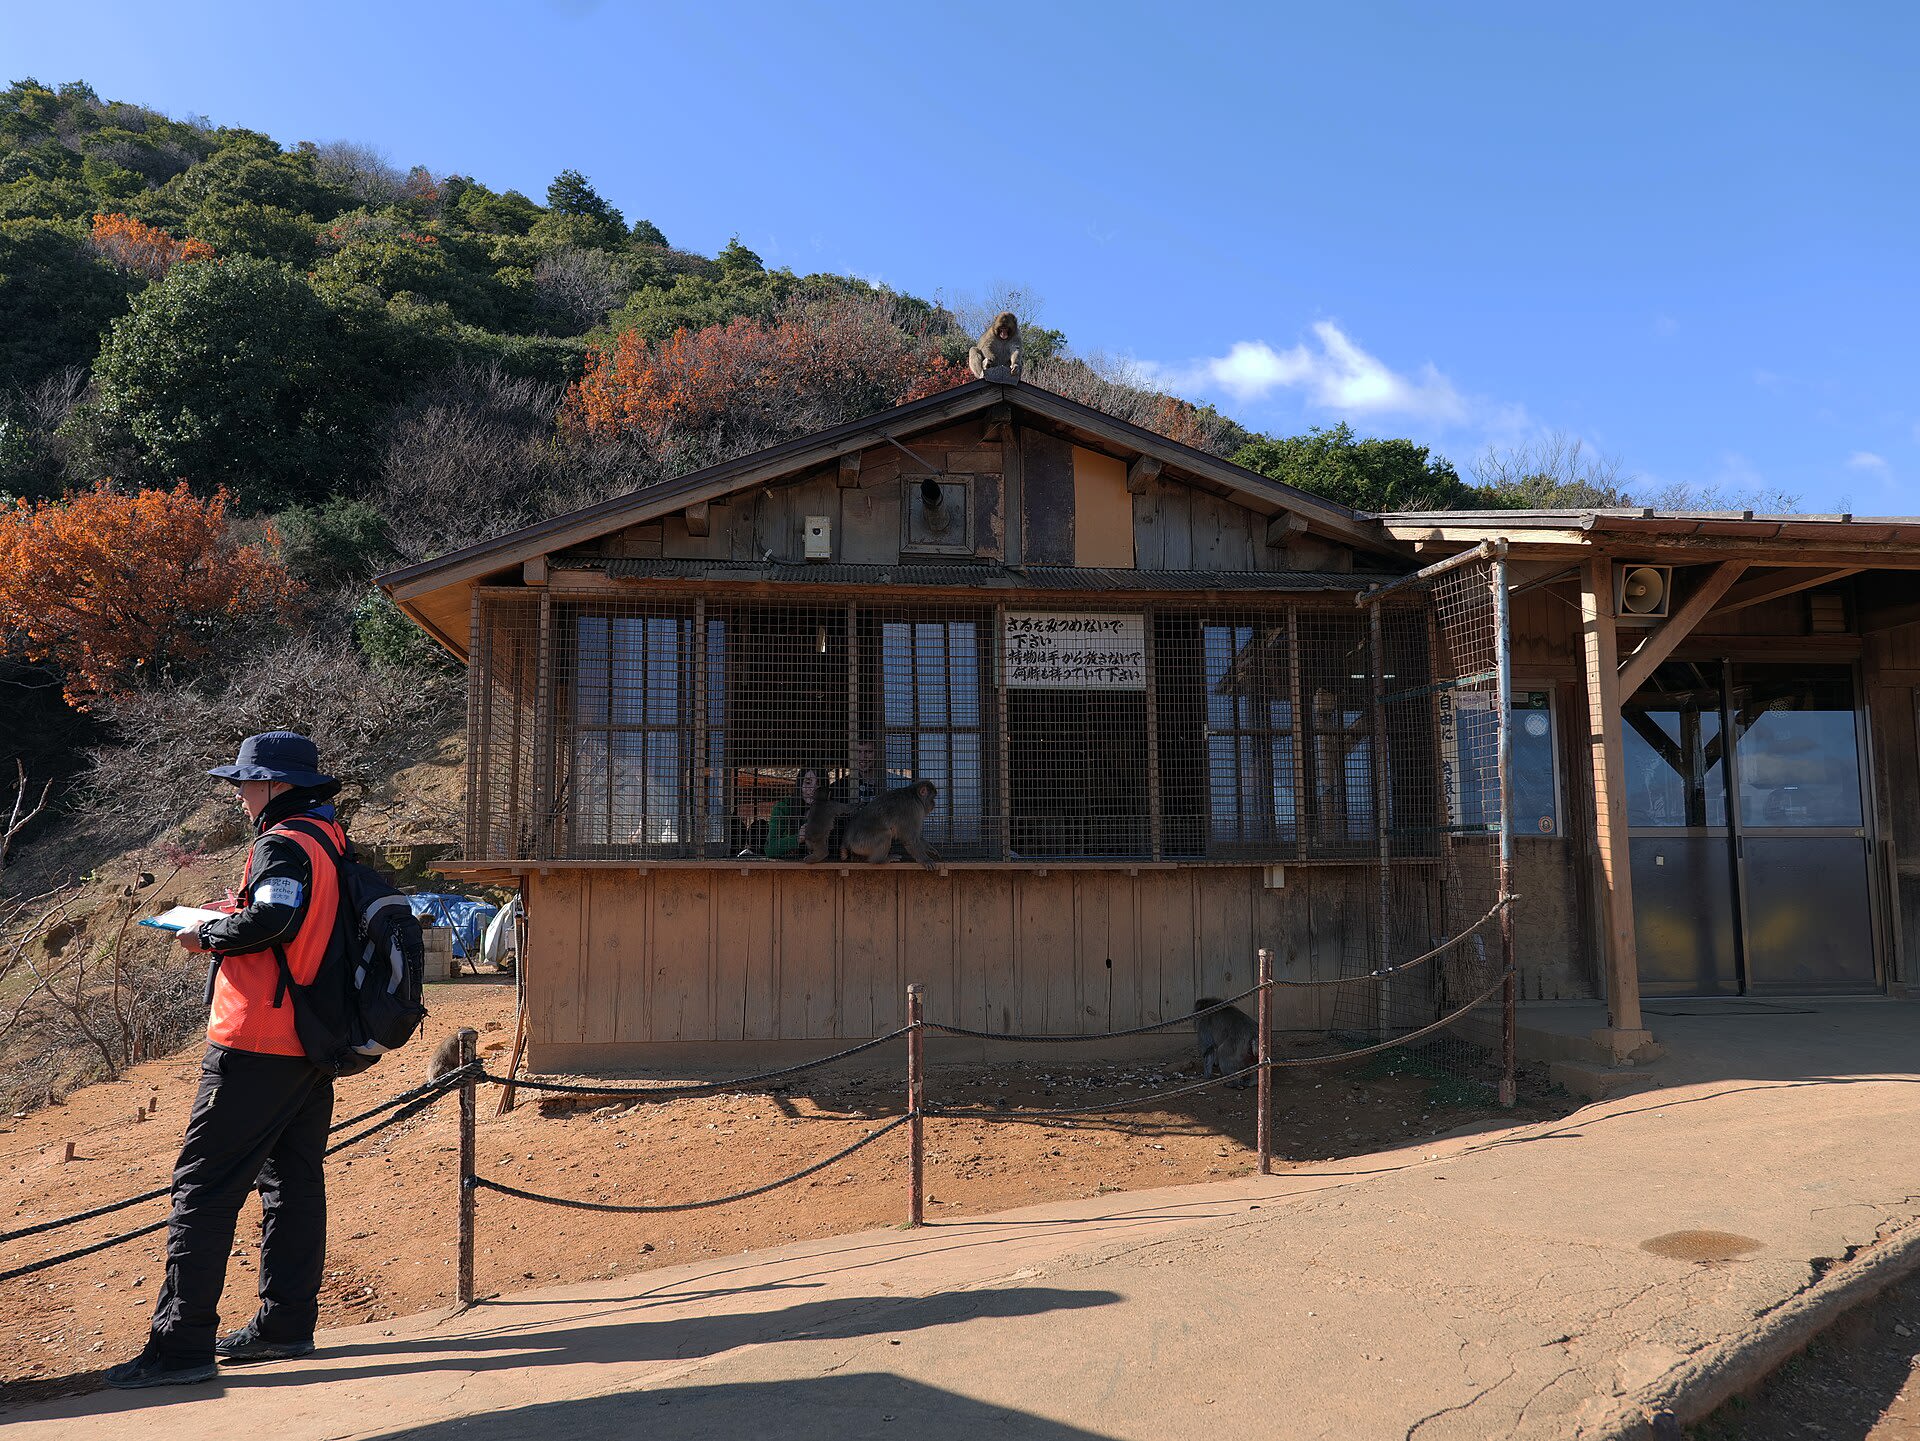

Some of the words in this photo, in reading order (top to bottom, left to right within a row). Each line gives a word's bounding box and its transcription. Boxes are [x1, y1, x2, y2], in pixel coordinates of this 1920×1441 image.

[1007, 616, 1124, 634] さるをみつめないで
